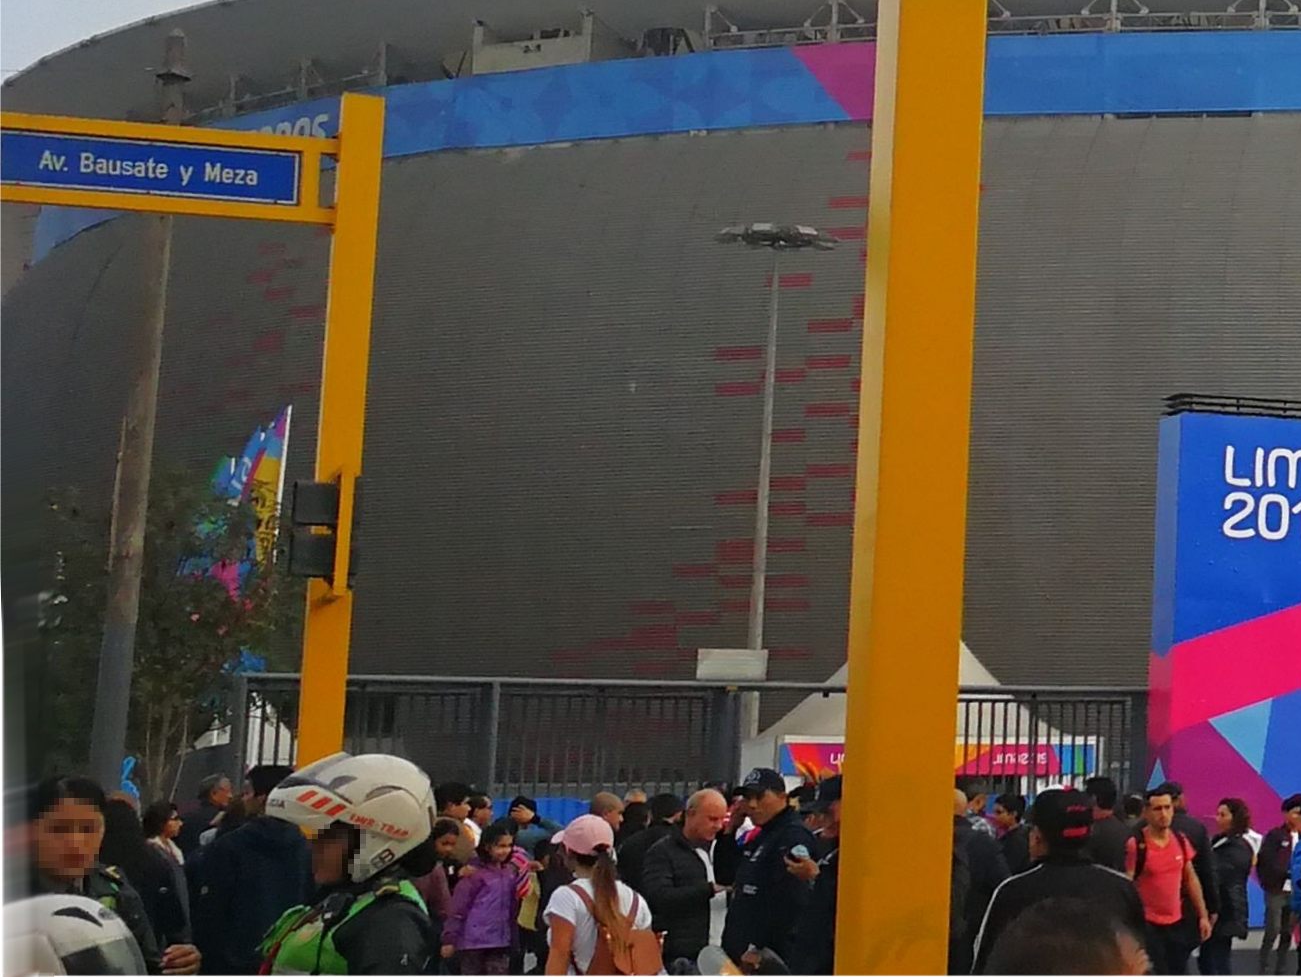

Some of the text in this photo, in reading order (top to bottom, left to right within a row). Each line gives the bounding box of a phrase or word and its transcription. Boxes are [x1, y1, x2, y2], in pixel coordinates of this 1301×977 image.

[39, 149, 259, 186] Av. Bausate y Meza
